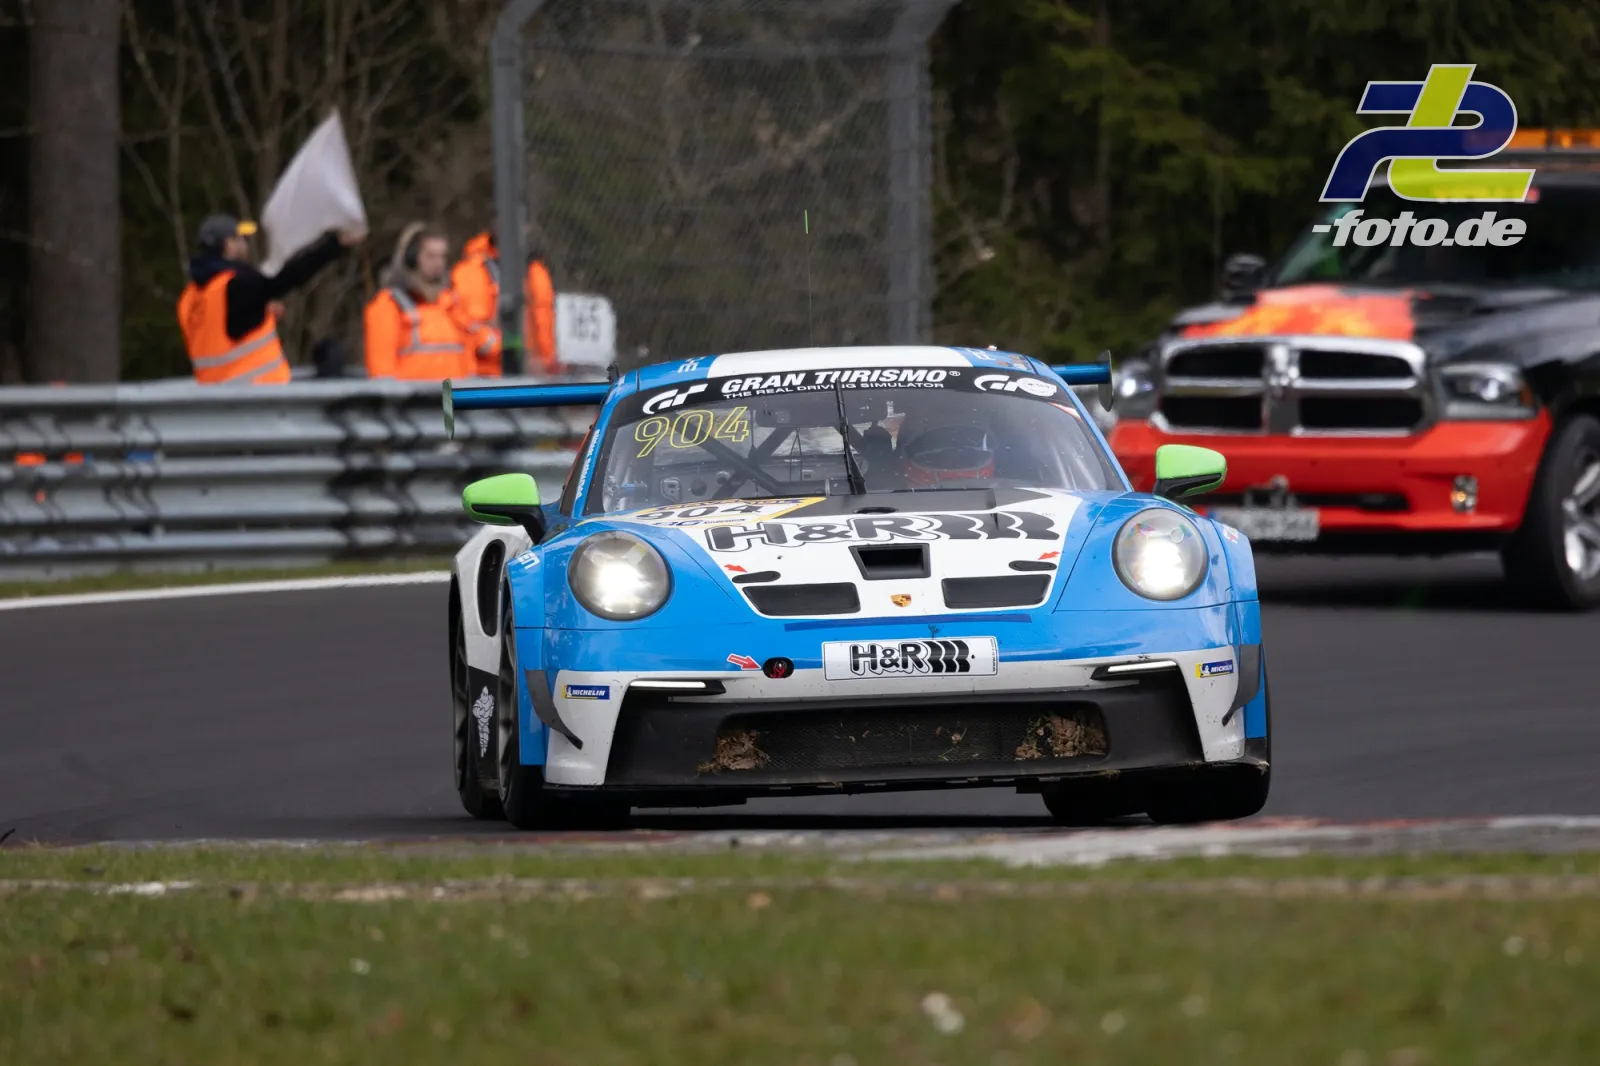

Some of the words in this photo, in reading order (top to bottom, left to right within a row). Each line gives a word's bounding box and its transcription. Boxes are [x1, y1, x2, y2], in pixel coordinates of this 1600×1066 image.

[721, 373, 806, 394] GRAN
[723, 390, 752, 400] THE
[756, 386, 791, 396] REAL
[634, 406, 750, 459] 904
[635, 504, 764, 520] 904
[572, 689, 606, 697] MICHELIN
